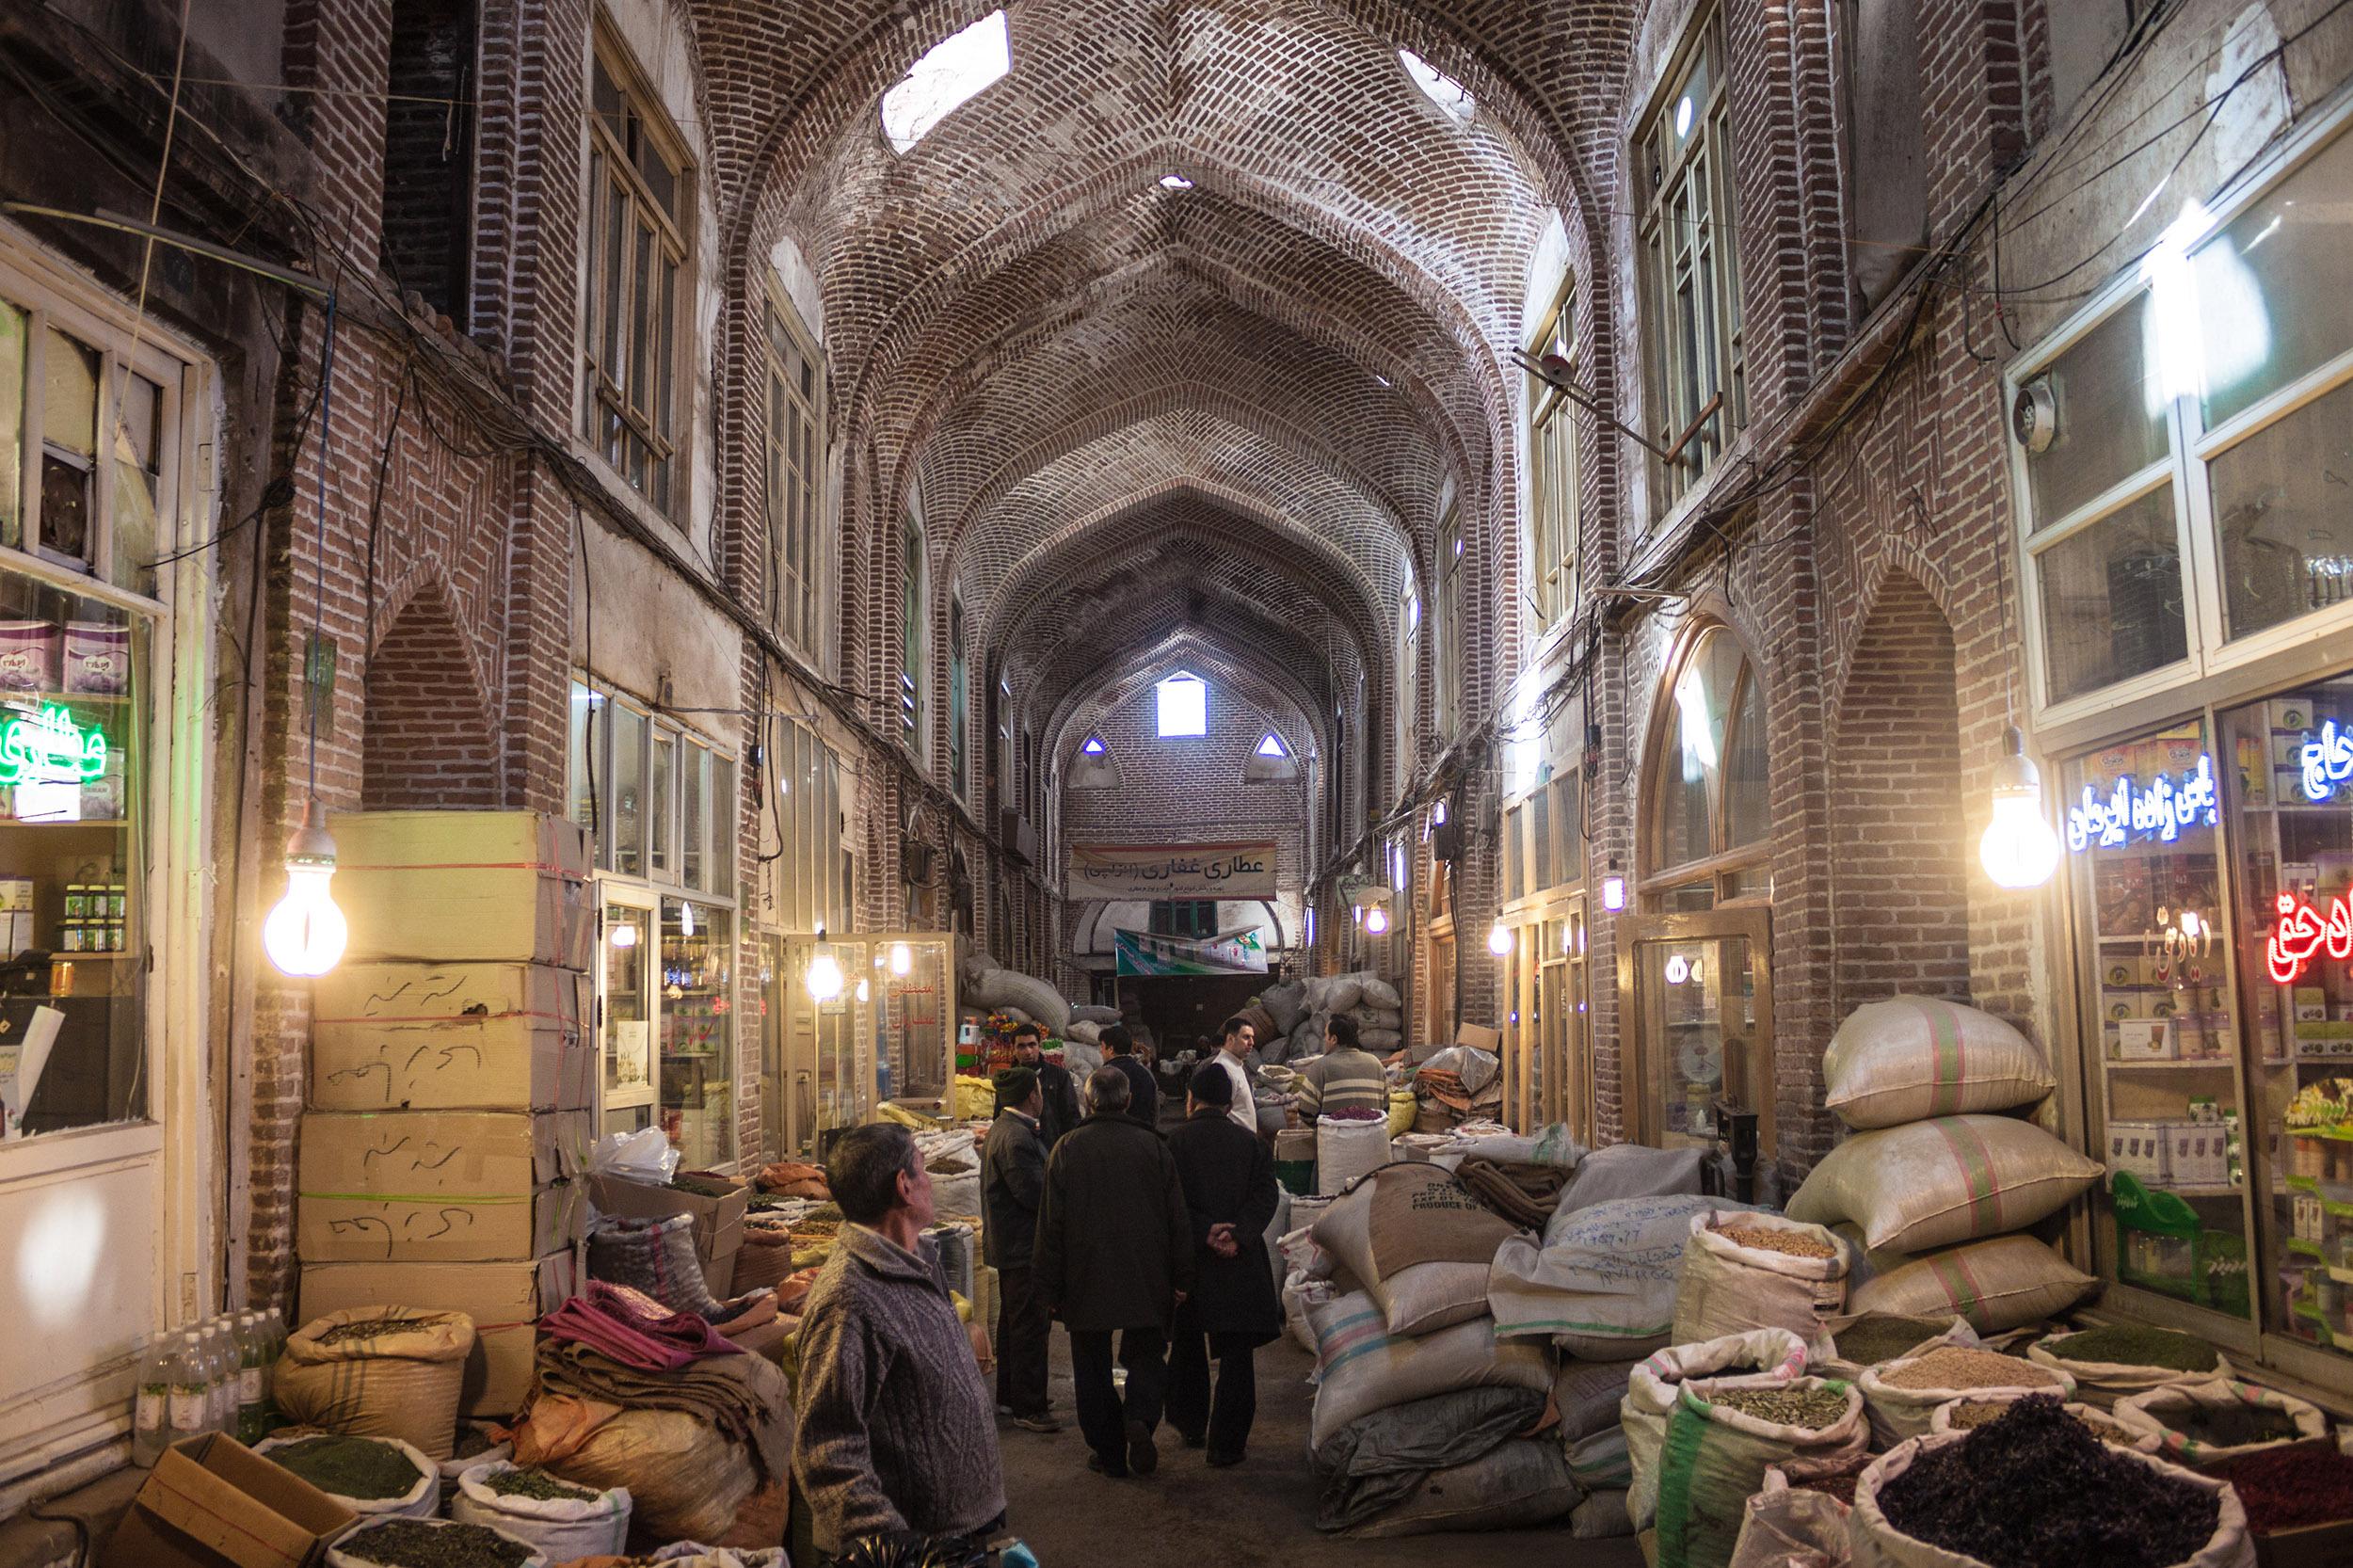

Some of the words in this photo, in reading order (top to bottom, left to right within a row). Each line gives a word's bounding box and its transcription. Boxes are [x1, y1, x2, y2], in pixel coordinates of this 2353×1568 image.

[1141, 857, 1202, 880] غفاری
[1204, 855, 1264, 880] عطاری
[1413, 1201, 1463, 1210] PRODUCE
